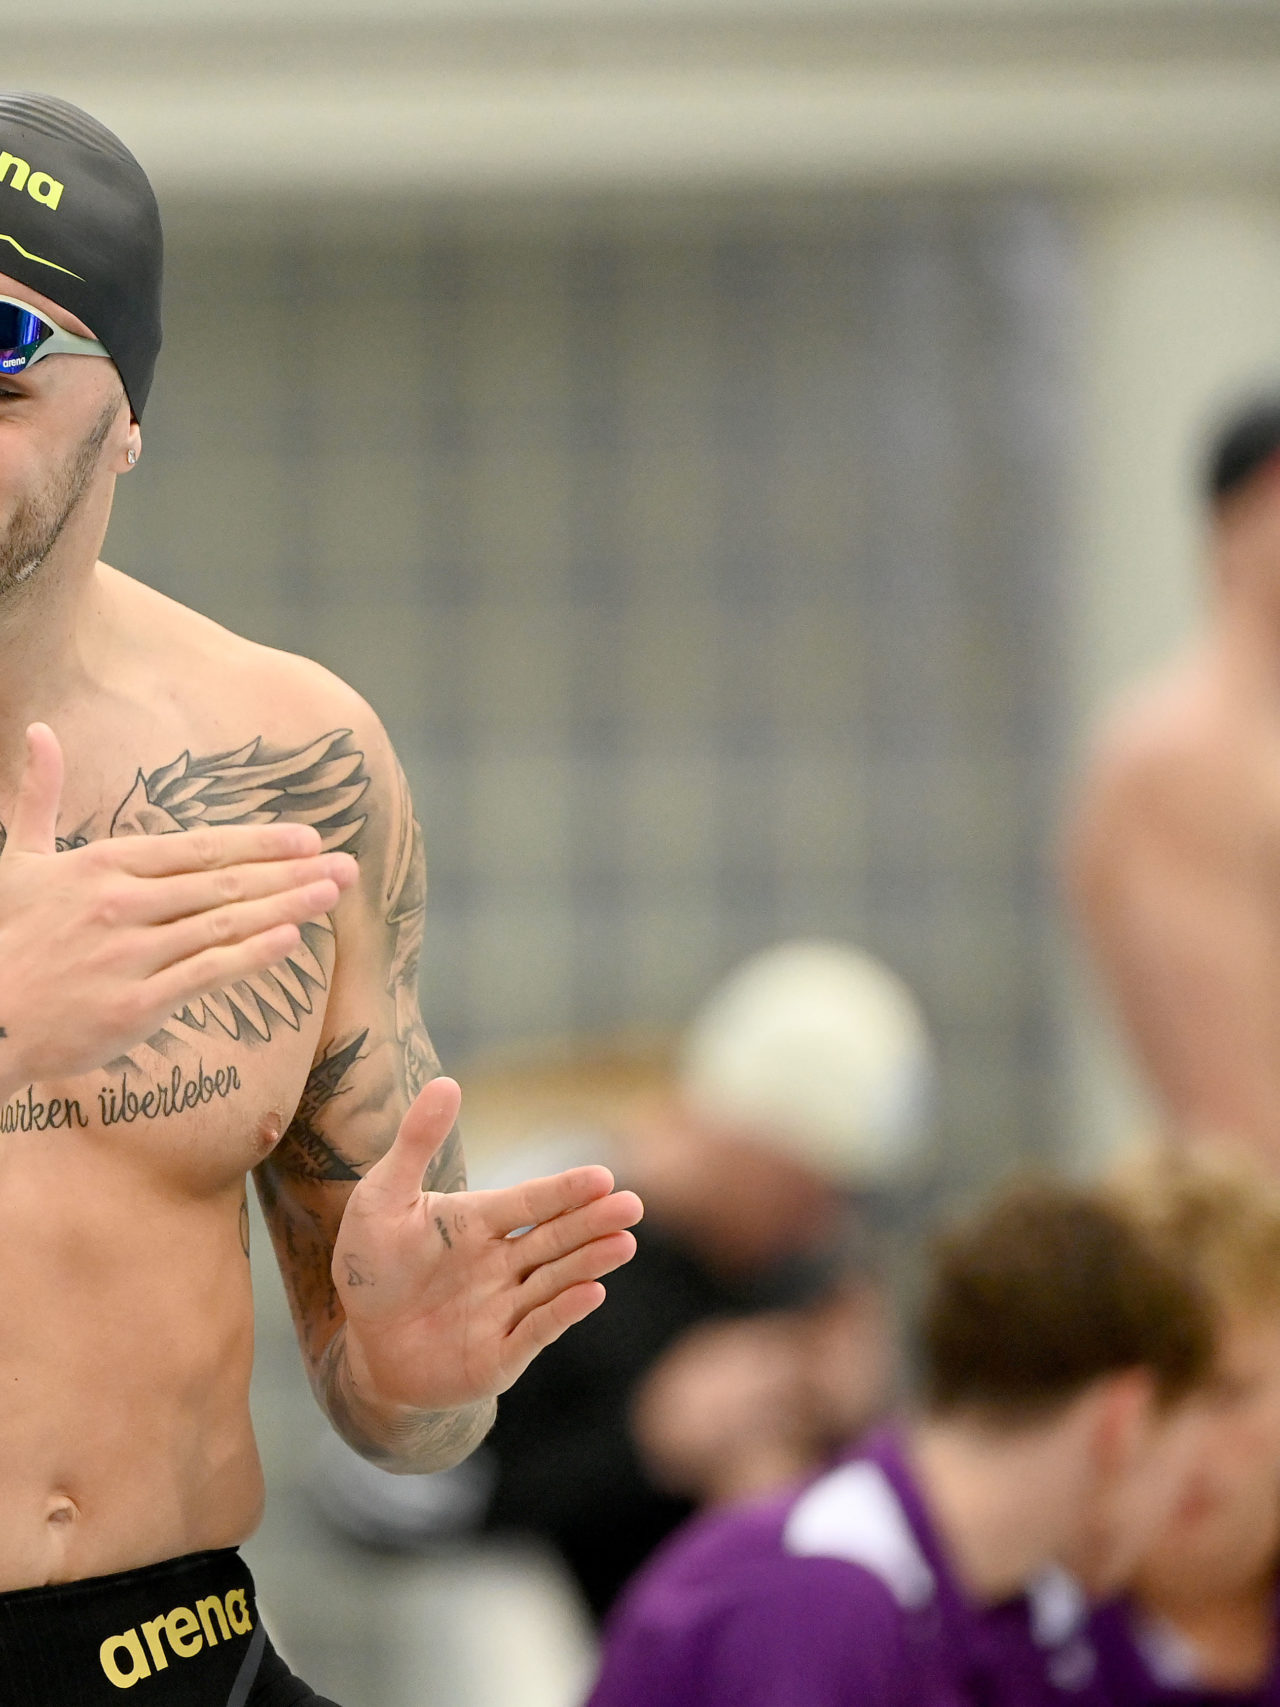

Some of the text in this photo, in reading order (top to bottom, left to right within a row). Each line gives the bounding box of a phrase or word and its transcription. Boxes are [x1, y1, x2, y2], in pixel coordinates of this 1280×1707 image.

[2, 356, 26, 368] arena
[98, 1056, 241, 1127] überleben
[99, 1588, 253, 1689] arena
